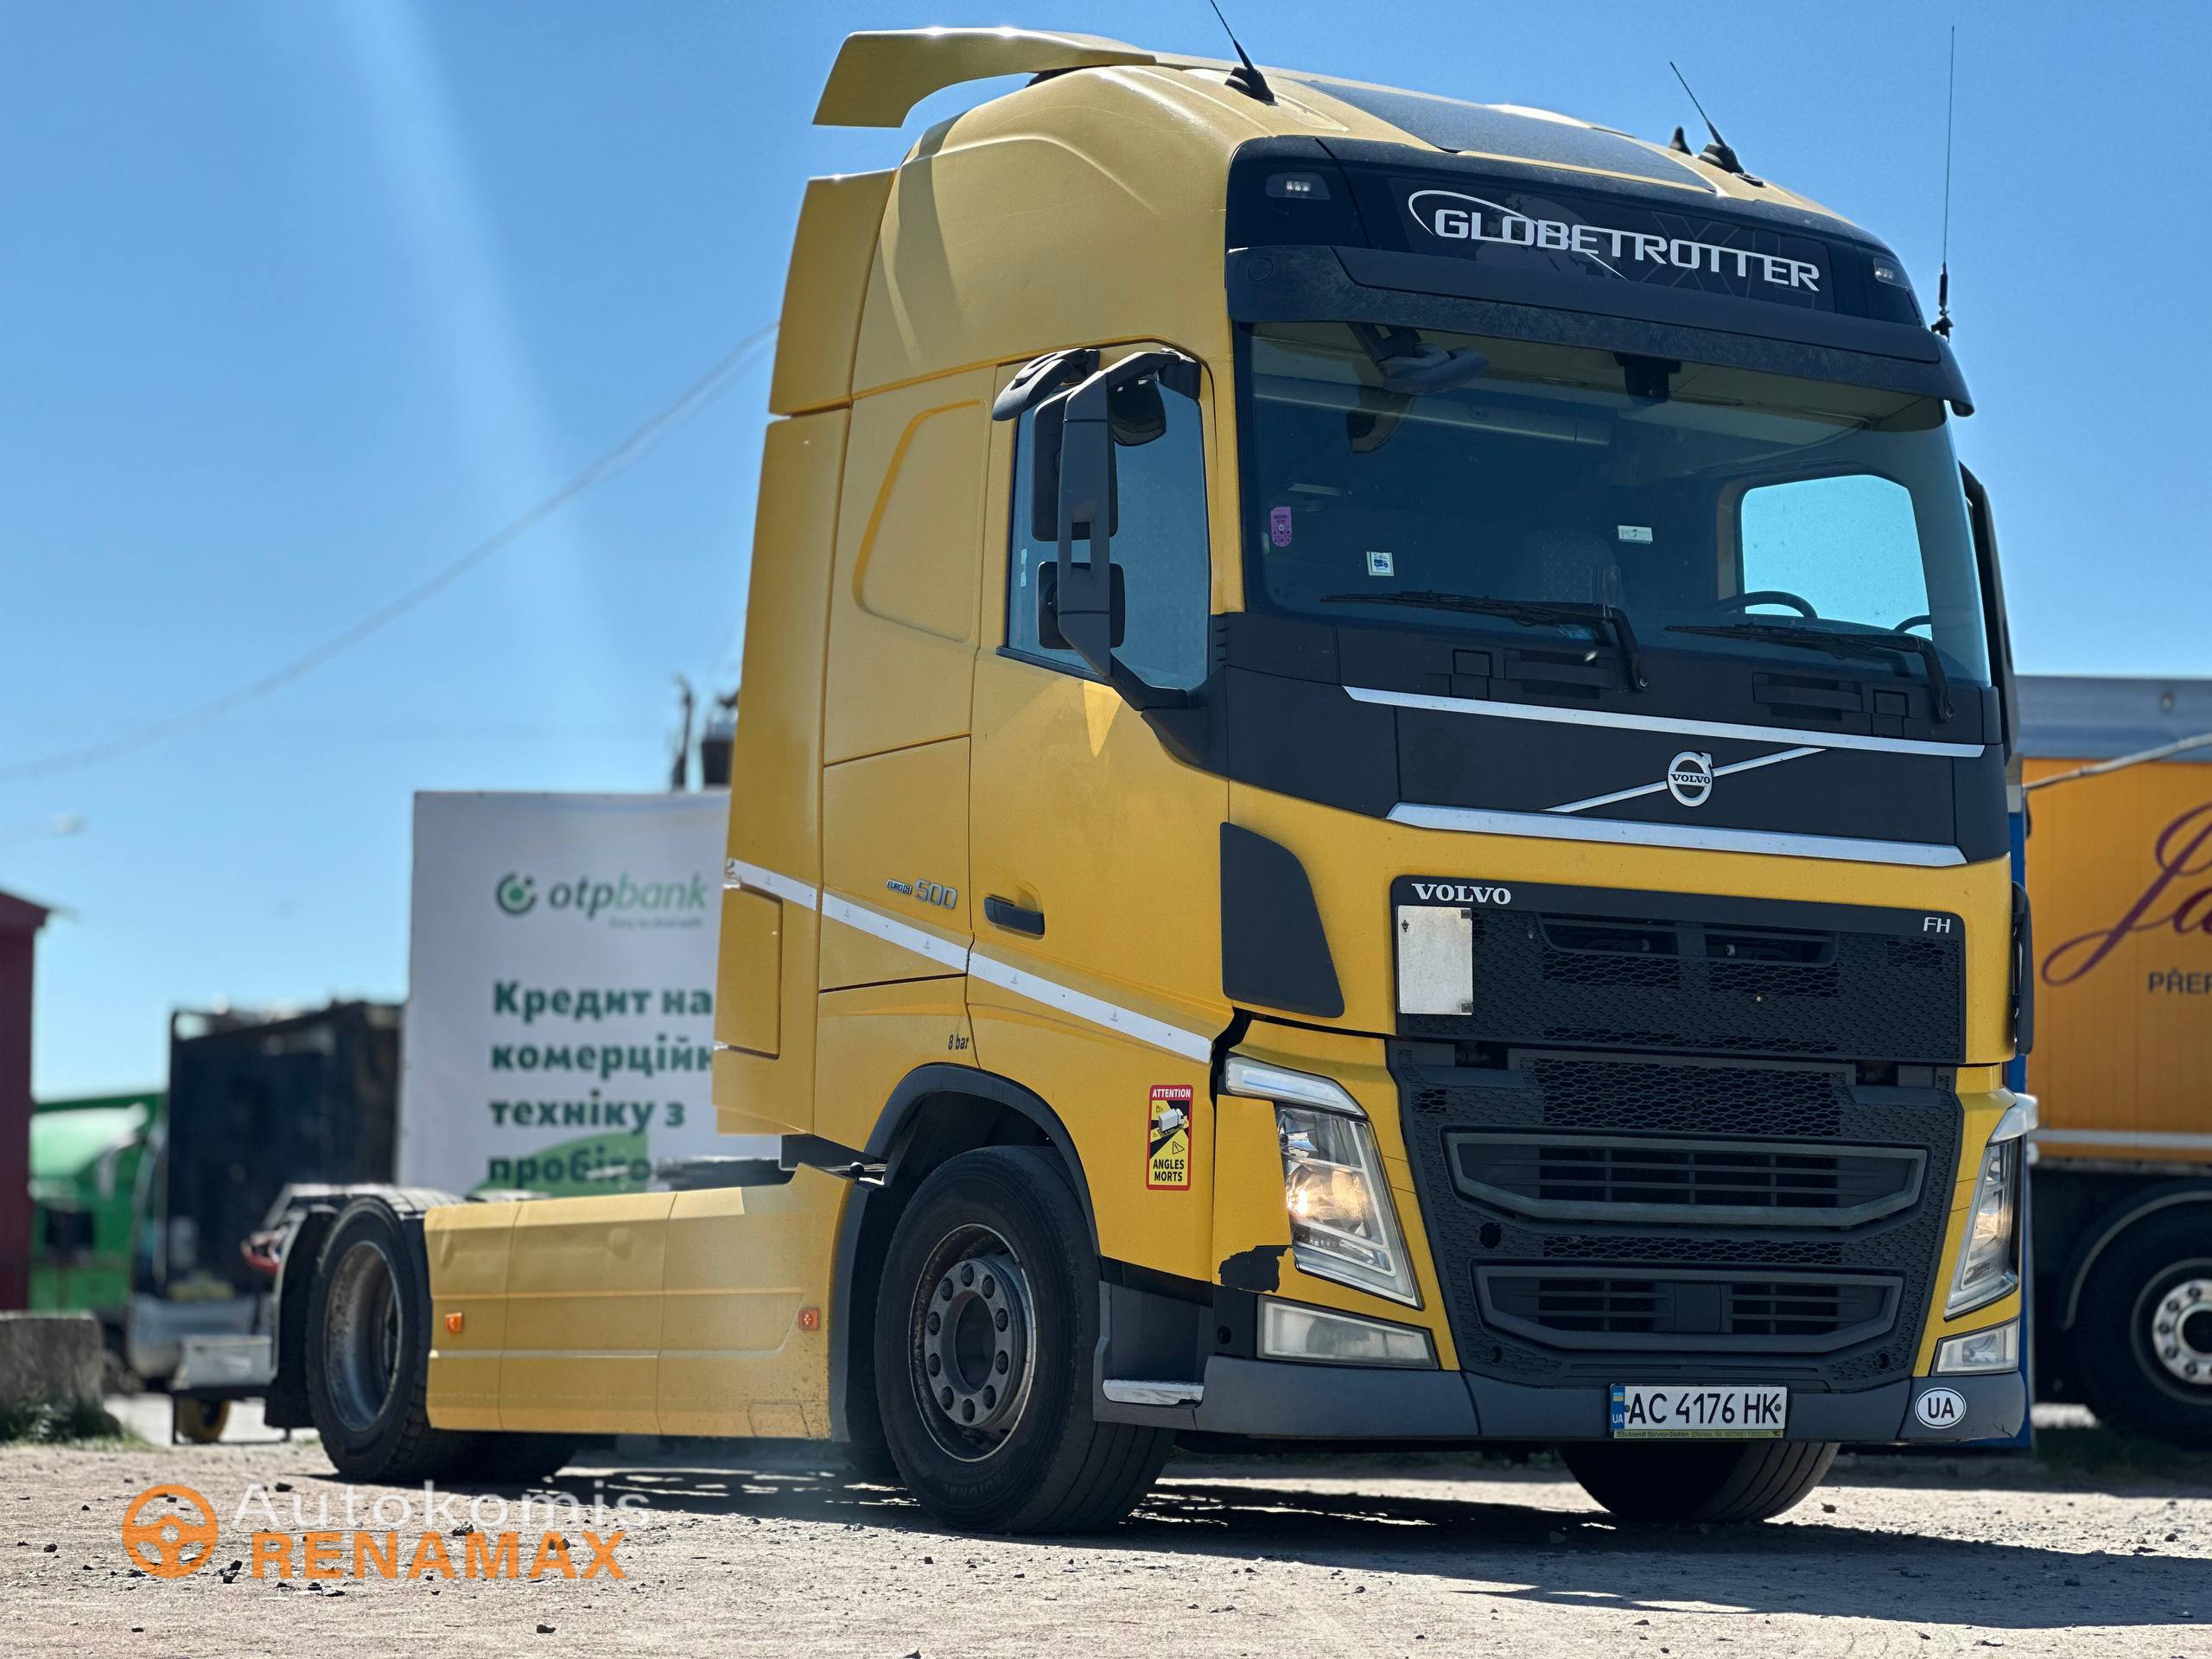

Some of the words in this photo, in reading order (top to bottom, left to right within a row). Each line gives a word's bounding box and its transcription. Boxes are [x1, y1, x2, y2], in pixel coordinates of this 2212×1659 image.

[1435, 209, 1819, 291] GLOBETROTTER
[1670, 773, 1711, 784] VOLVO
[549, 872, 708, 918] otpbank
[915, 879, 957, 910] 500
[1412, 882, 1511, 906] VOLVO
[1923, 917, 1950, 934] FH
[493, 980, 652, 1022] Кредит
[662, 990, 712, 1015] на
[948, 1034, 954, 1050] 8
[956, 1035, 969, 1050] bar
[1153, 1088, 1191, 1098] ATTENTION
[489, 1090, 654, 1134] техніку
[664, 1101, 685, 1127] з
[1153, 1159, 1185, 1169] ANGLES
[1154, 1171, 1183, 1182] MORTS
[1612, 1414, 1624, 1424] UA
[1628, 1393, 1667, 1424] AC
[1675, 1392, 1735, 1424] 4176
[1744, 1393, 1780, 1424] HK
[1928, 1397, 1955, 1419] UA
